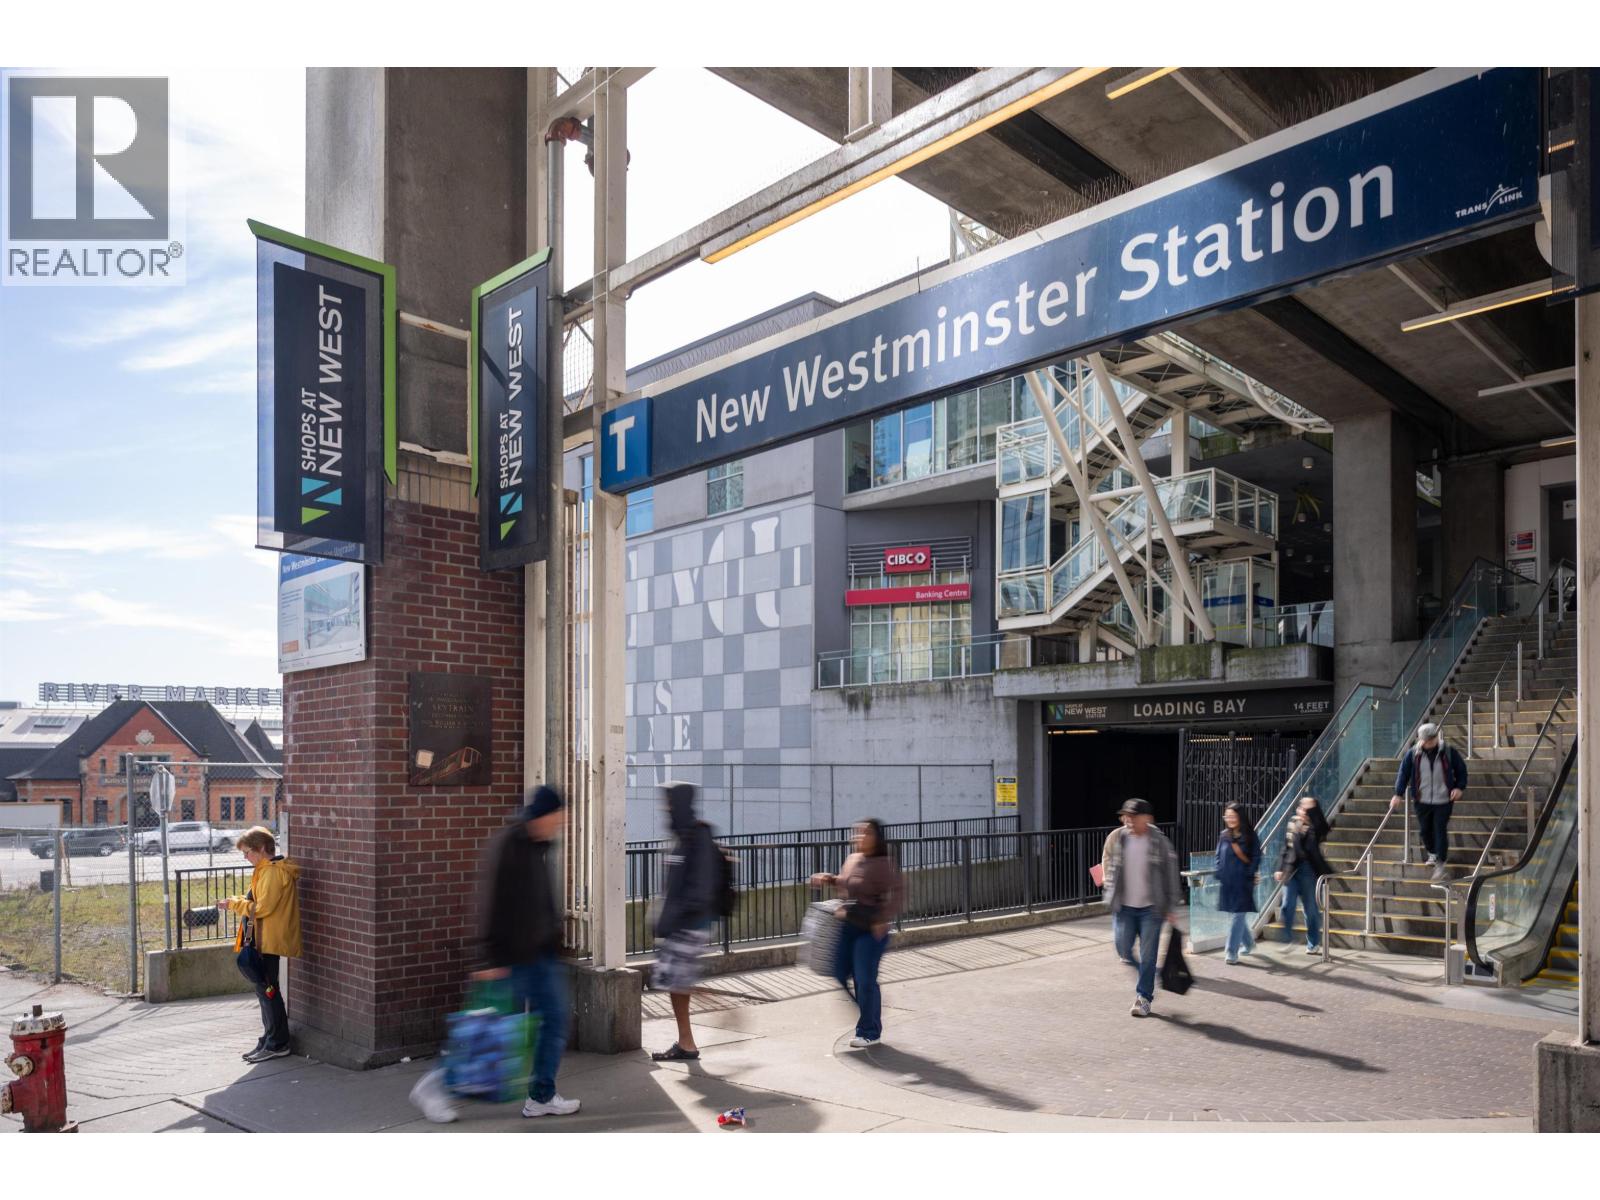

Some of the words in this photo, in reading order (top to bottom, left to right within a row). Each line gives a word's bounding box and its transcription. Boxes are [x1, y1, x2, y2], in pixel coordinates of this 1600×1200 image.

[696, 384, 771, 443] New
[783, 265, 1099, 413] Westminster
[1120, 164, 1394, 302] Station
[319, 284, 342, 383] WEST
[509, 307, 522, 401] WEST
[302, 387, 317, 410] AT
[319, 391, 342, 477] NEW
[500, 412, 509, 429] AT
[302, 412, 317, 472] SHOPS
[500, 433, 509, 489] SHOPS
[509, 409, 522, 487] NEW
[609, 415, 635, 472] T
[887, 553, 914, 565] CIBC
[915, 590, 943, 600] Banking
[944, 589, 968, 598] Centre
[43, 682, 143, 702] RIVER
[1065, 707, 1083, 716] NEW
[1083, 706, 1107, 715] WEST
[1133, 700, 1206, 717] LOADING
[1213, 699, 1247, 714] BAY
[1294, 702, 1304, 711] 14
[1306, 701, 1329, 710] FEET
